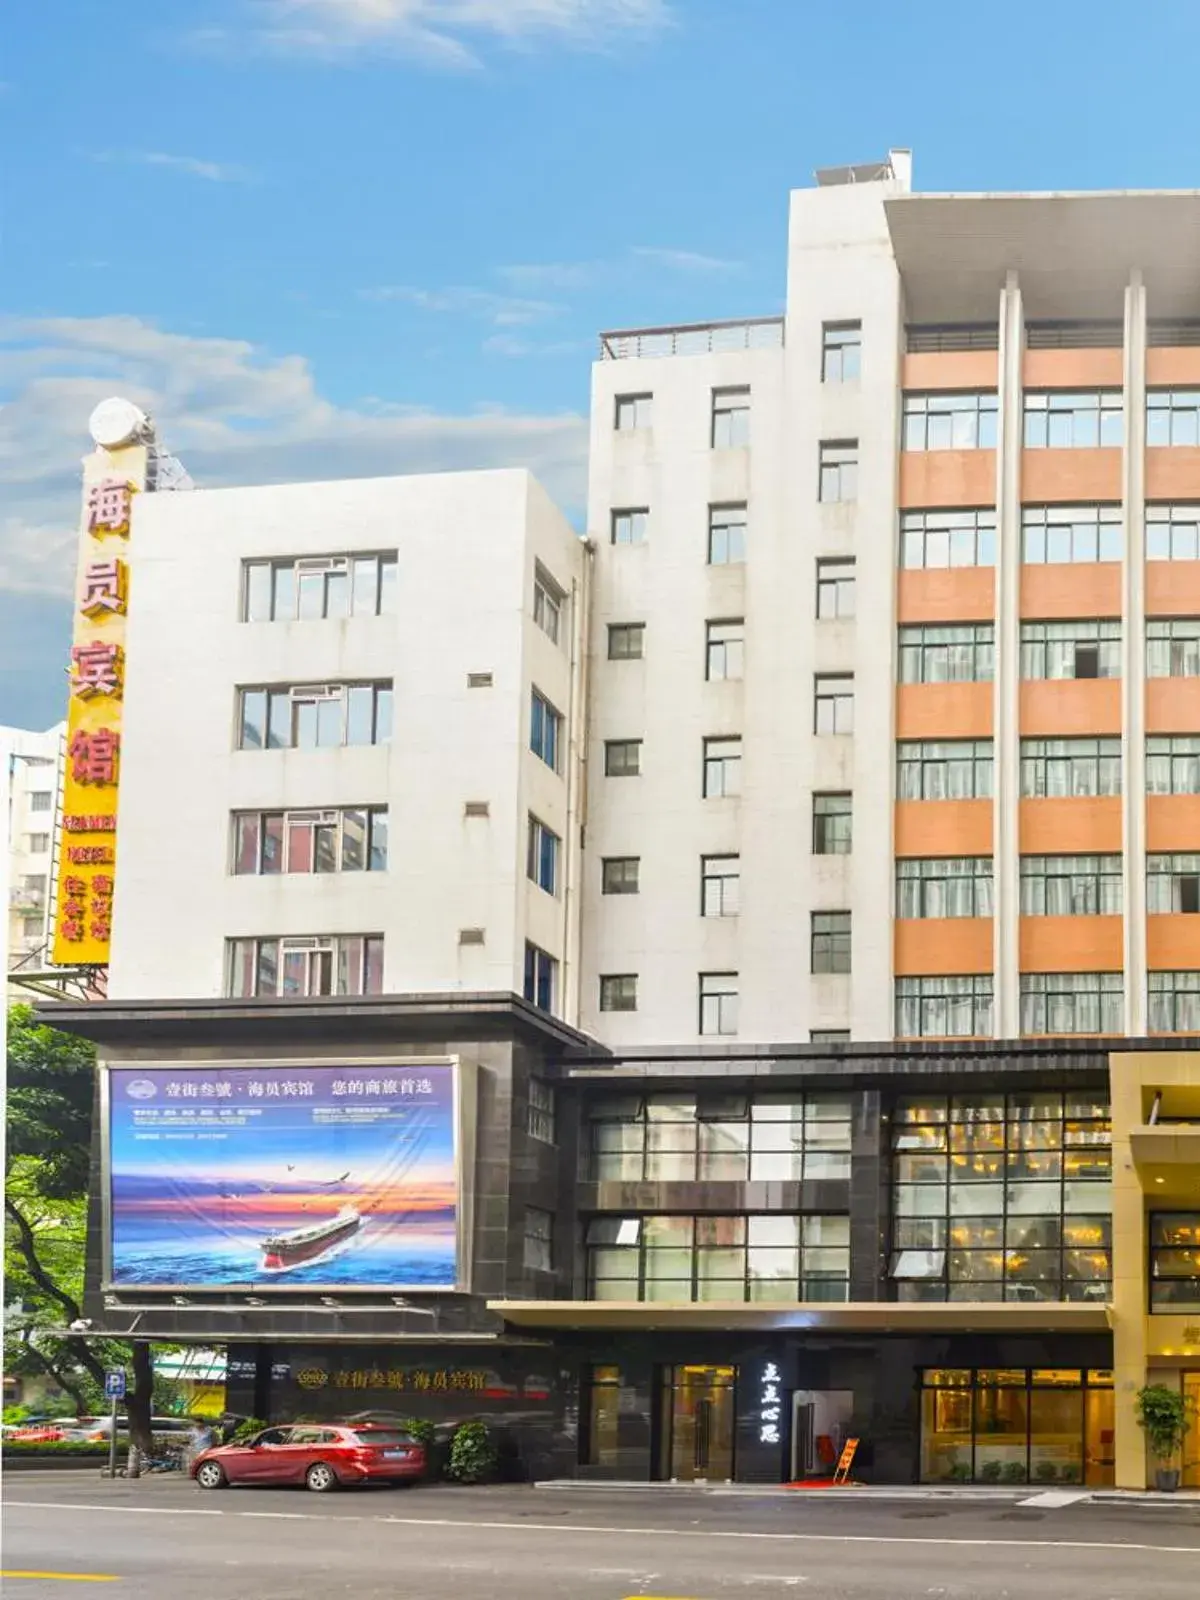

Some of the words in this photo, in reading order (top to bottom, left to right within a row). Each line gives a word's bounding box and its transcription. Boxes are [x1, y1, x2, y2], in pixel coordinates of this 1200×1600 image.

[70, 477, 131, 789] 海员宾馆
[109, 1374, 121, 1393] P
